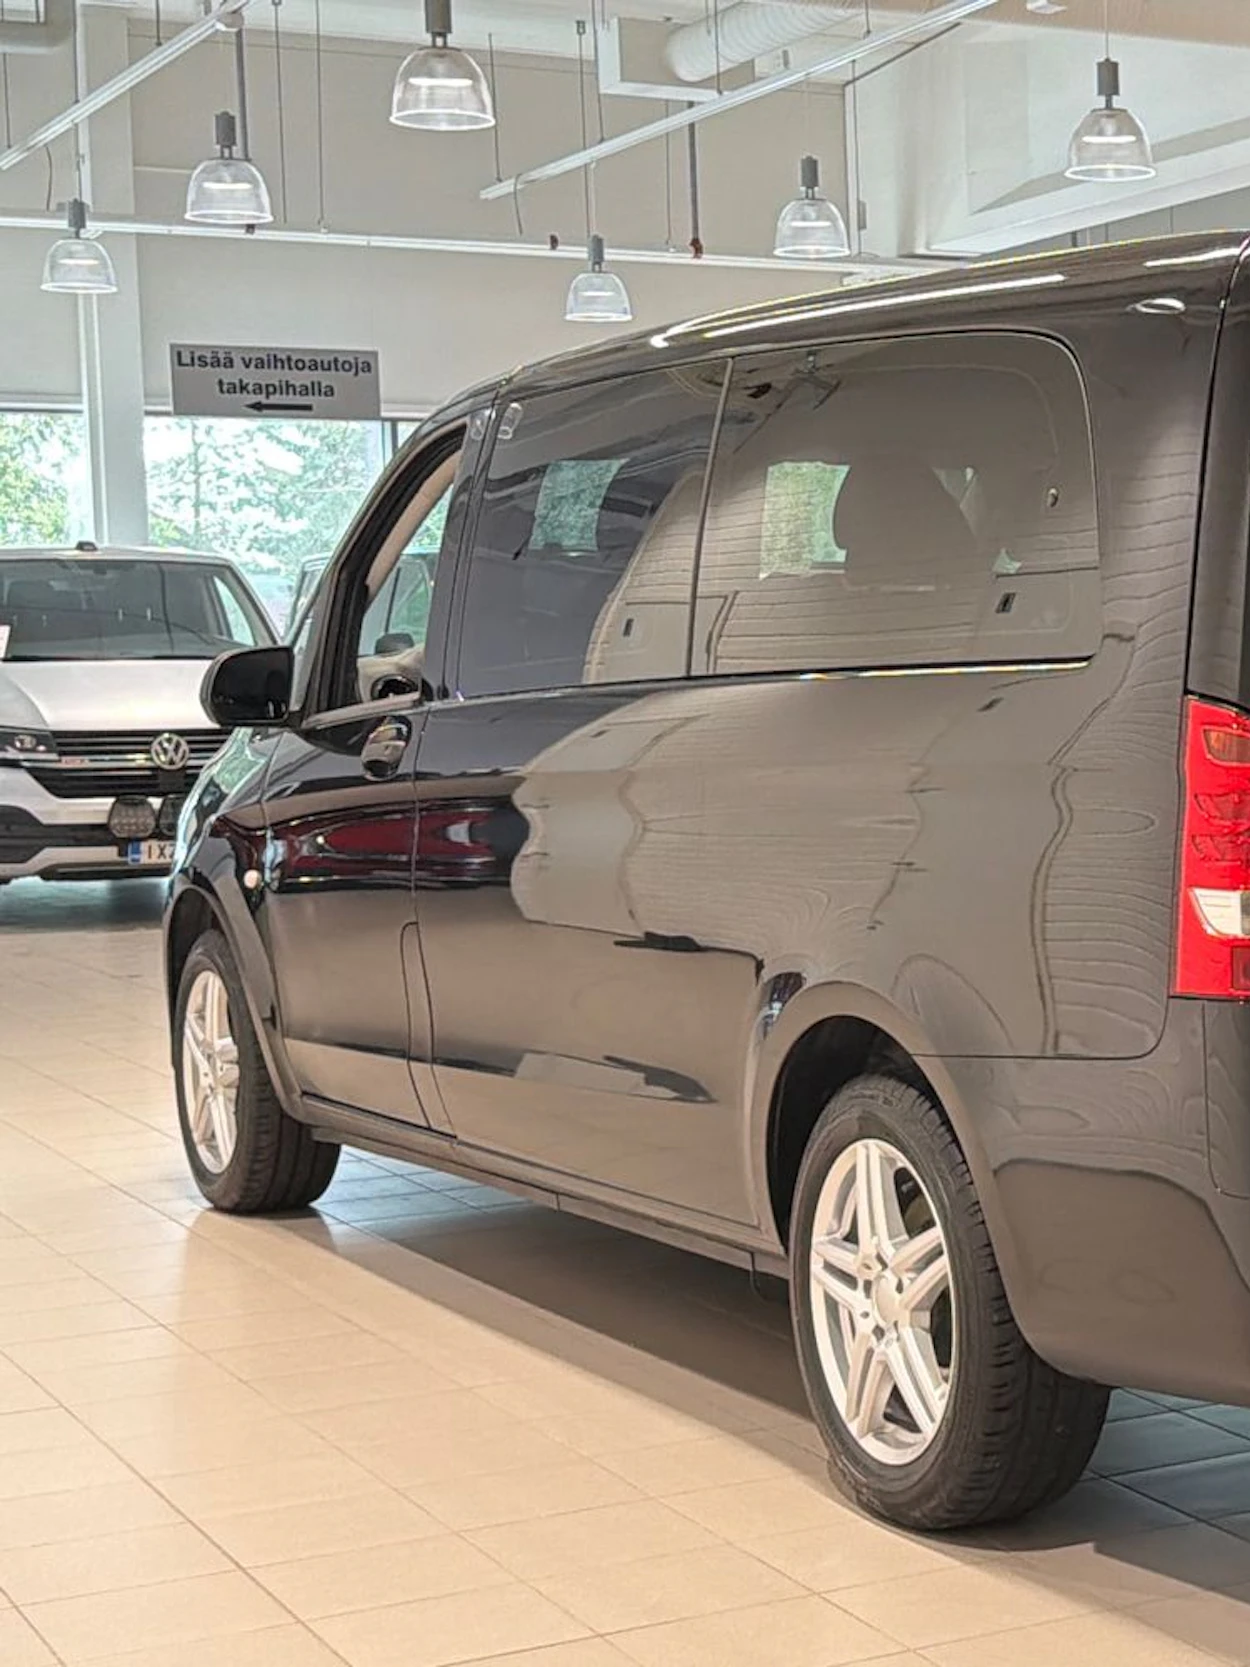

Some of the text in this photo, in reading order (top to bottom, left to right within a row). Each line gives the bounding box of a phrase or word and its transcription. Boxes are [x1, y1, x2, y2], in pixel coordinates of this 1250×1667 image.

[176, 350, 373, 377] Lisää vaihtoautoja
[217, 378, 335, 400] takapihalla
